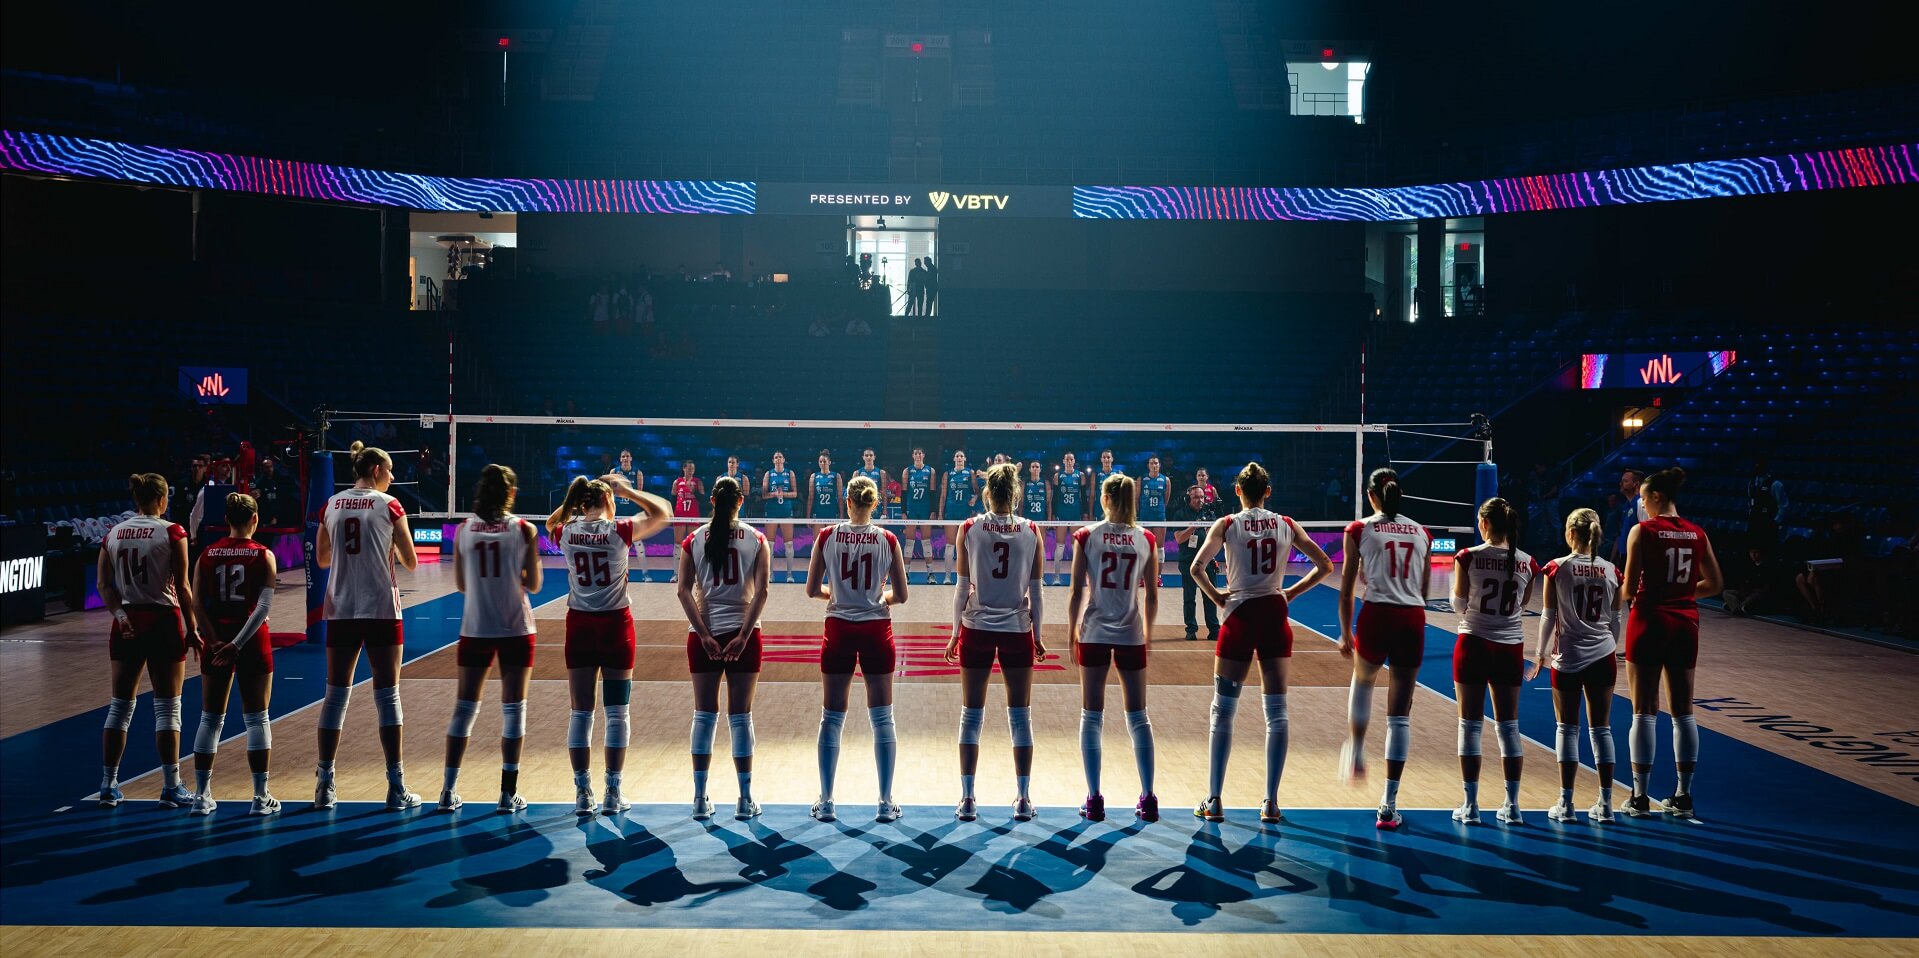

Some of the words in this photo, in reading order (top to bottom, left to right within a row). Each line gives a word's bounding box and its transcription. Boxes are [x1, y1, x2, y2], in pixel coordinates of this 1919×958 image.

[810, 194, 889, 205] PRESENTED
[895, 195, 912, 205] BY
[952, 194, 1010, 210] VBTV
[1640, 354, 1683, 384] VNL
[196, 372, 230, 397] VNL
[819, 493, 831, 505] 22
[912, 487, 925, 500] 27
[954, 489, 963, 501] 11
[1063, 493, 1075, 505] 35
[1149, 496, 1159, 507] 19
[334, 498, 375, 510] STYSIAK
[682, 500, 692, 512] 17
[1030, 501, 1042, 513] 28
[116, 527, 155, 540] WOŁOSZ
[344, 517, 361, 555] 9
[414, 530, 443, 542] 05:53
[704, 529, 745, 541] FSIO
[1373, 522, 1418, 535] SMARZEK
[568, 533, 610, 545] JURCZYK
[1103, 533, 1135, 546] PACAK
[474, 540, 501, 578] 11
[992, 541, 1010, 579] 3
[1247, 537, 1277, 575] 19
[1385, 540, 1415, 579] 17
[117, 547, 149, 586] 14
[573, 551, 611, 587] 95
[841, 552, 873, 590] 41
[1101, 551, 1138, 590] 27
[1475, 557, 1528, 574] WENEKA
[1664, 546, 1693, 584] 15
[215, 563, 246, 601] 12
[1573, 584, 1604, 622] 16
